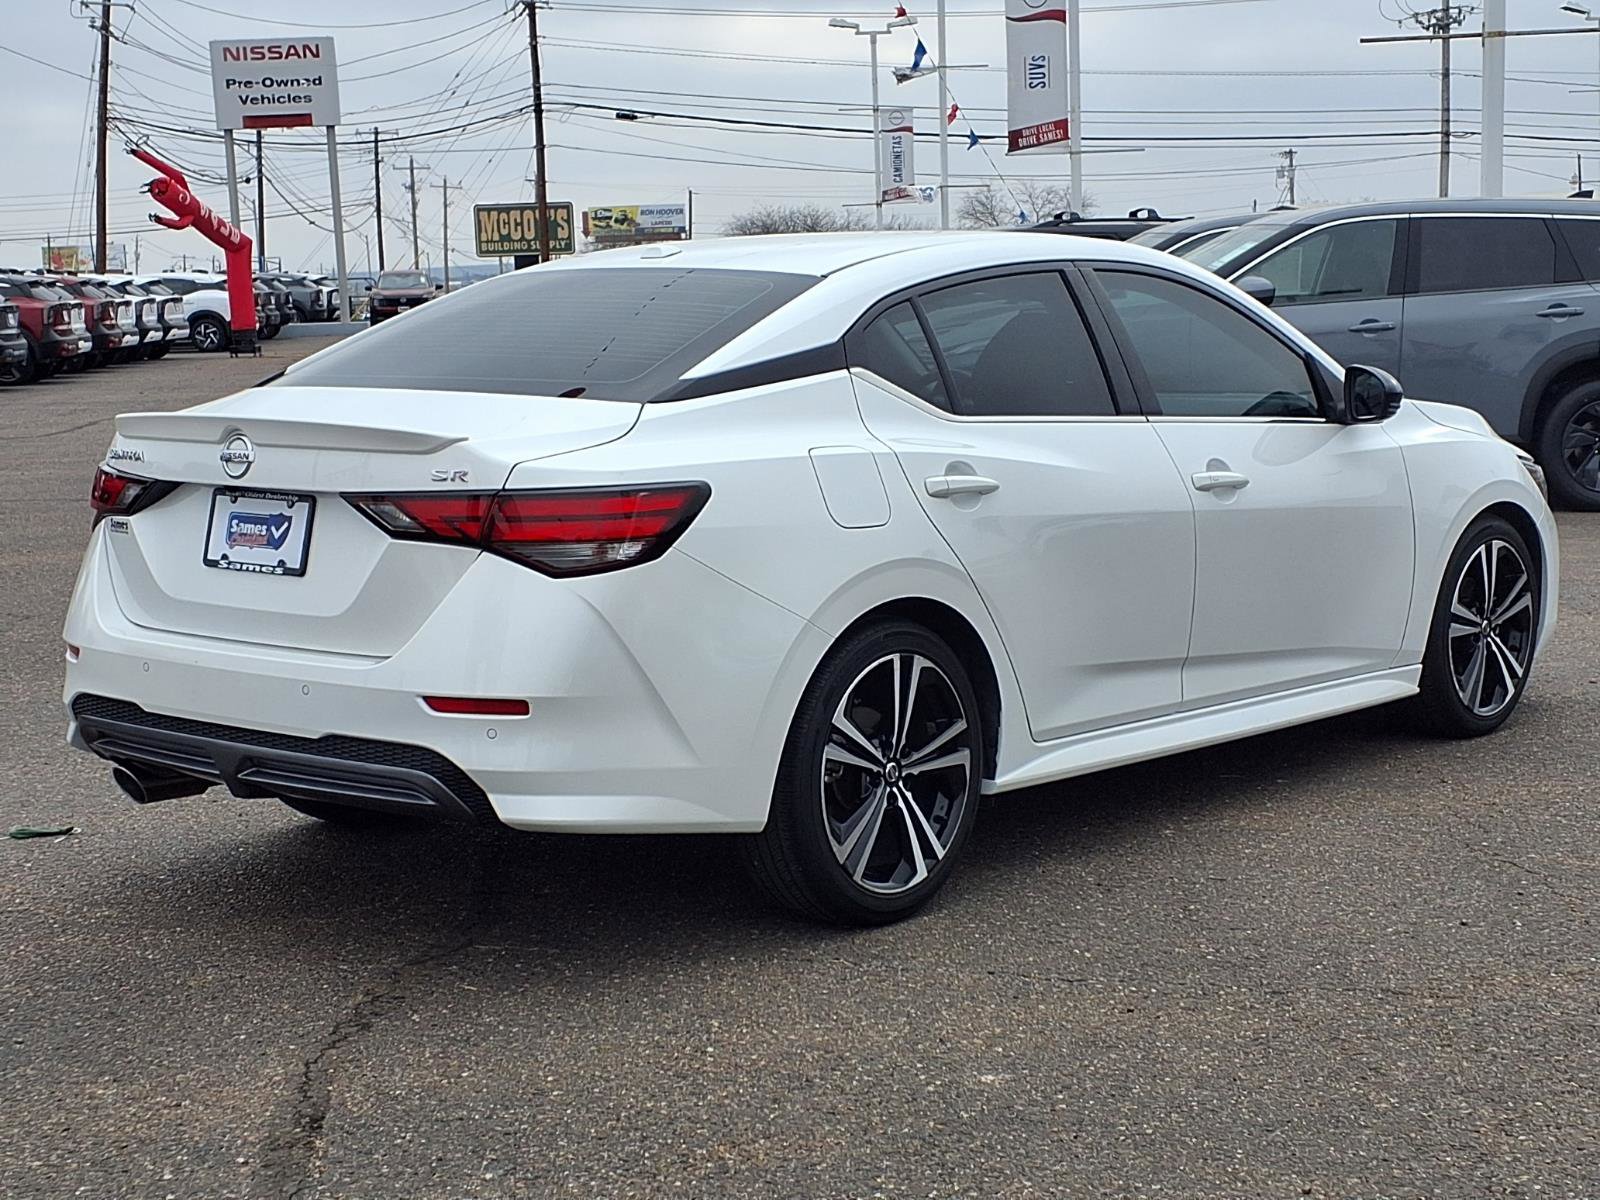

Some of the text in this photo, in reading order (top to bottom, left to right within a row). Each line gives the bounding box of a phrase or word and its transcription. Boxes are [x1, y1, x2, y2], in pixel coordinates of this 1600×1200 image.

[222, 43, 321, 62] NISSAN
[1028, 55, 1047, 89] SUVs
[225, 75, 322, 90] Pre-Owned
[238, 92, 313, 105] Vehicles
[1022, 122, 1056, 137] DRIVE LOCAL
[1018, 129, 1064, 148] DRIVE SAMES!
[892, 135, 904, 184] CAMIONETAS
[481, 241, 528, 252] BUILDING
[431, 469, 469, 483] SR
[230, 519, 268, 536] Sames
[217, 560, 285, 575] Sames
